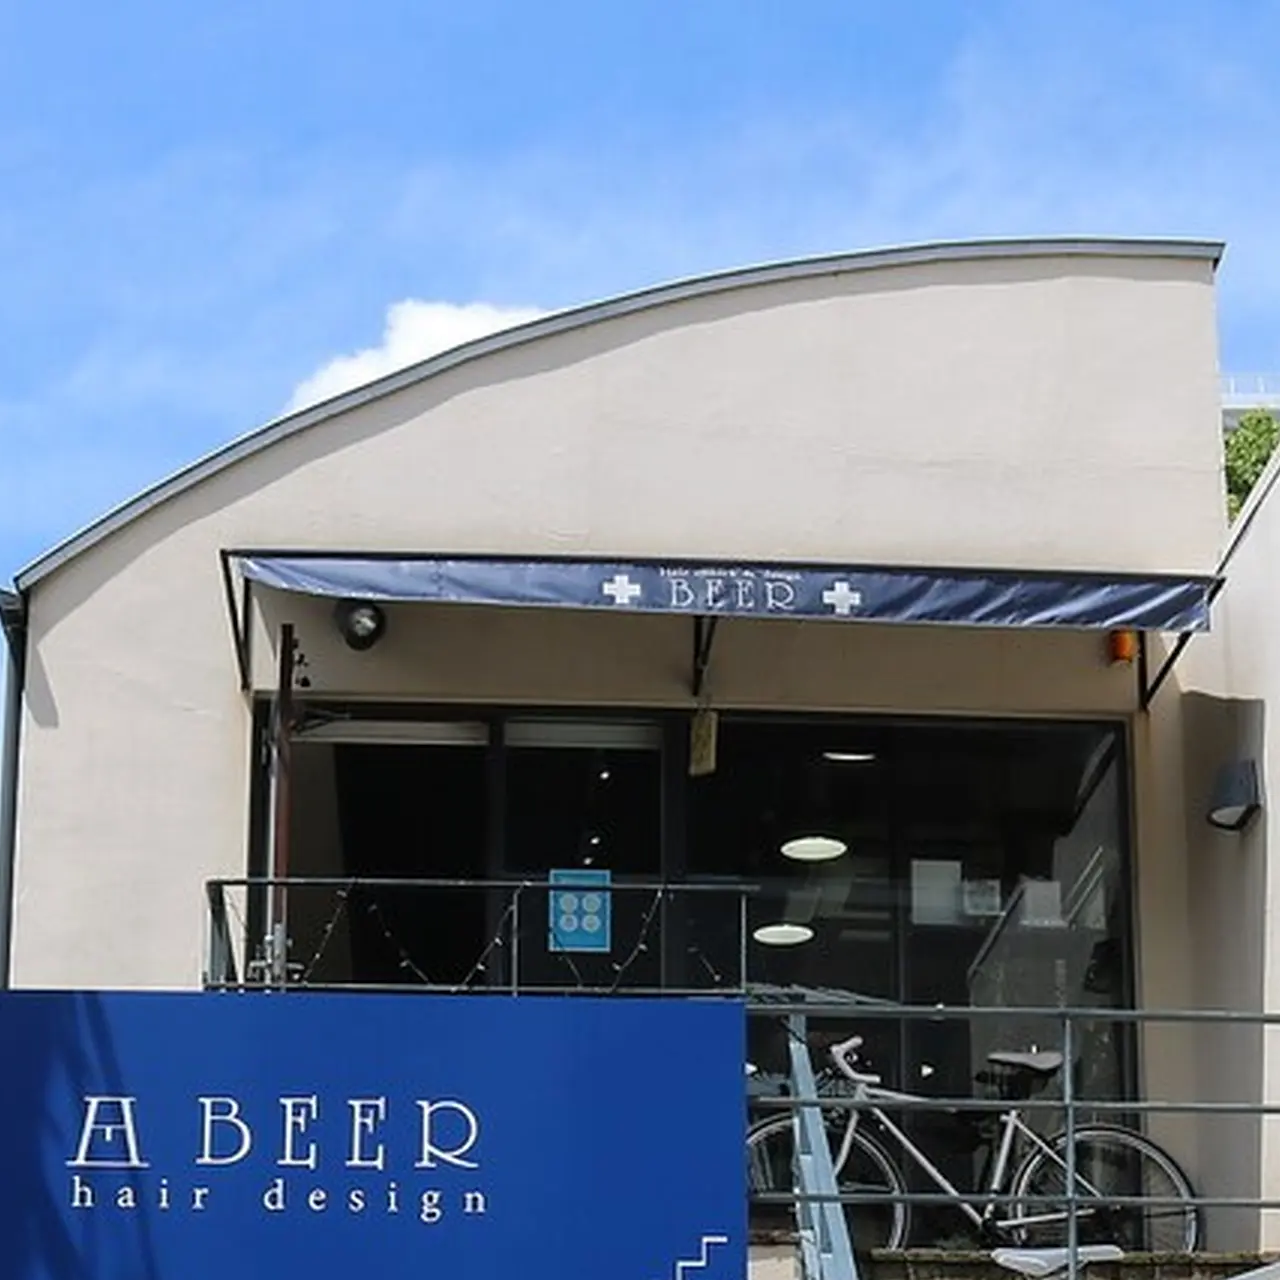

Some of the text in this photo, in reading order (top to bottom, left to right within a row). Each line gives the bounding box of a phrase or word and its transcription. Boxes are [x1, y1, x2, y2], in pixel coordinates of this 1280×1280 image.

[670, 577, 796, 611] BEER
[195, 1094, 480, 1171] BEER
[71, 1175, 487, 1222] hair design
